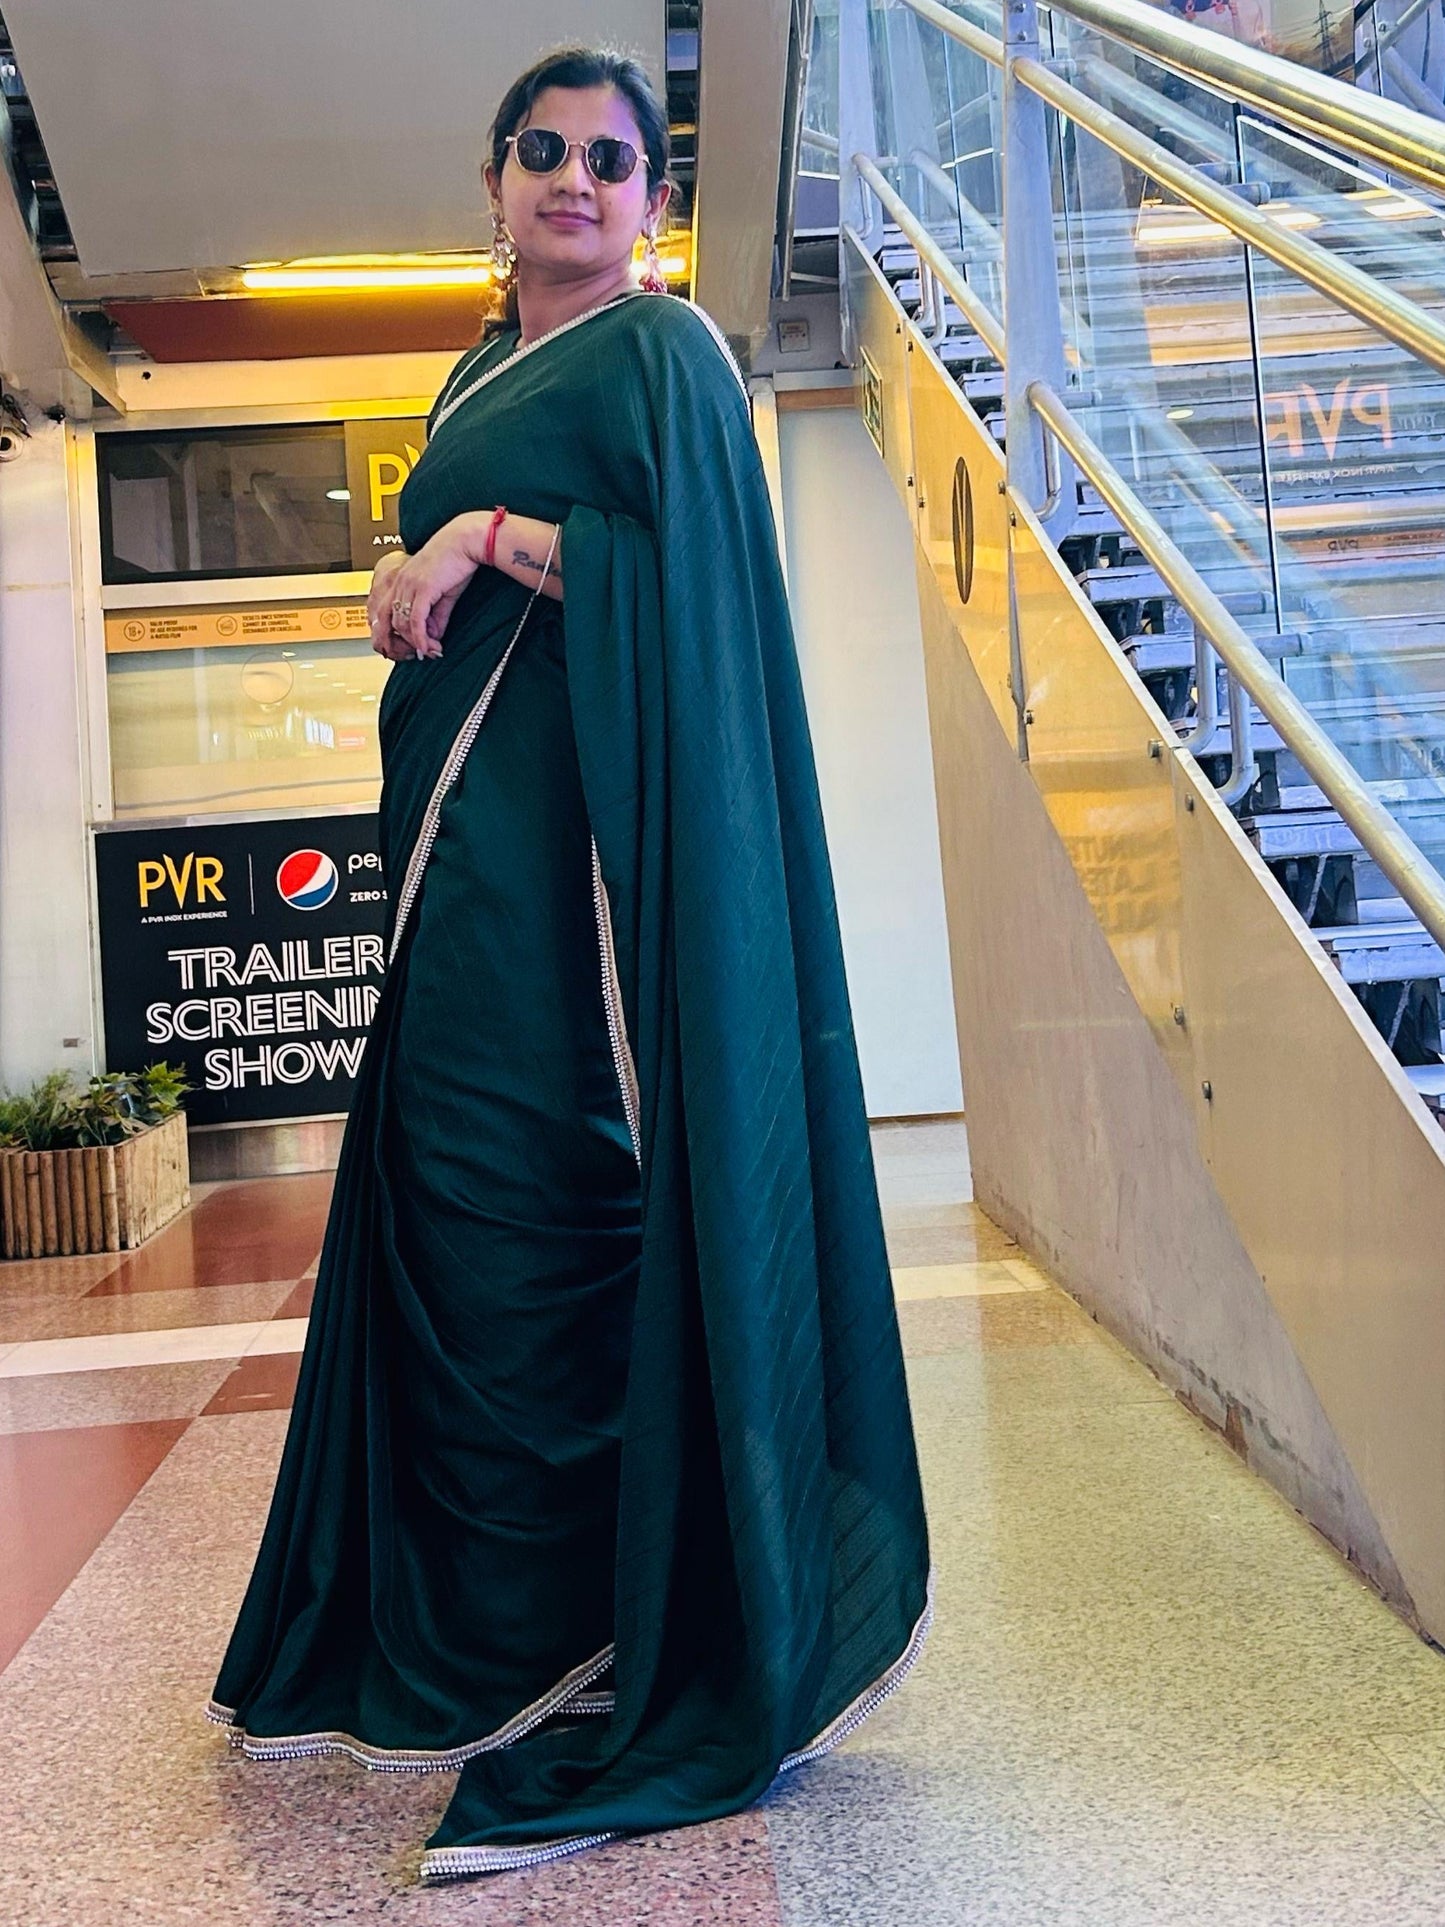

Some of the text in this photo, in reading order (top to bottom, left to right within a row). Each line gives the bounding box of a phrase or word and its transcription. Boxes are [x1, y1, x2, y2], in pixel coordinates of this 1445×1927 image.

[368, 442, 421, 521] P
[373, 535, 403, 545] A PV
[128, 626, 142, 637] 18+
[138, 851, 227, 910] PVR
[349, 890, 381, 903] ZERO
[148, 915, 164, 923] PVR
[164, 914, 182, 923] INOX
[183, 910, 228, 921] EXPERIENCE
[167, 934, 385, 990] TRAILER
[204, 1036, 368, 1091] SHOW
